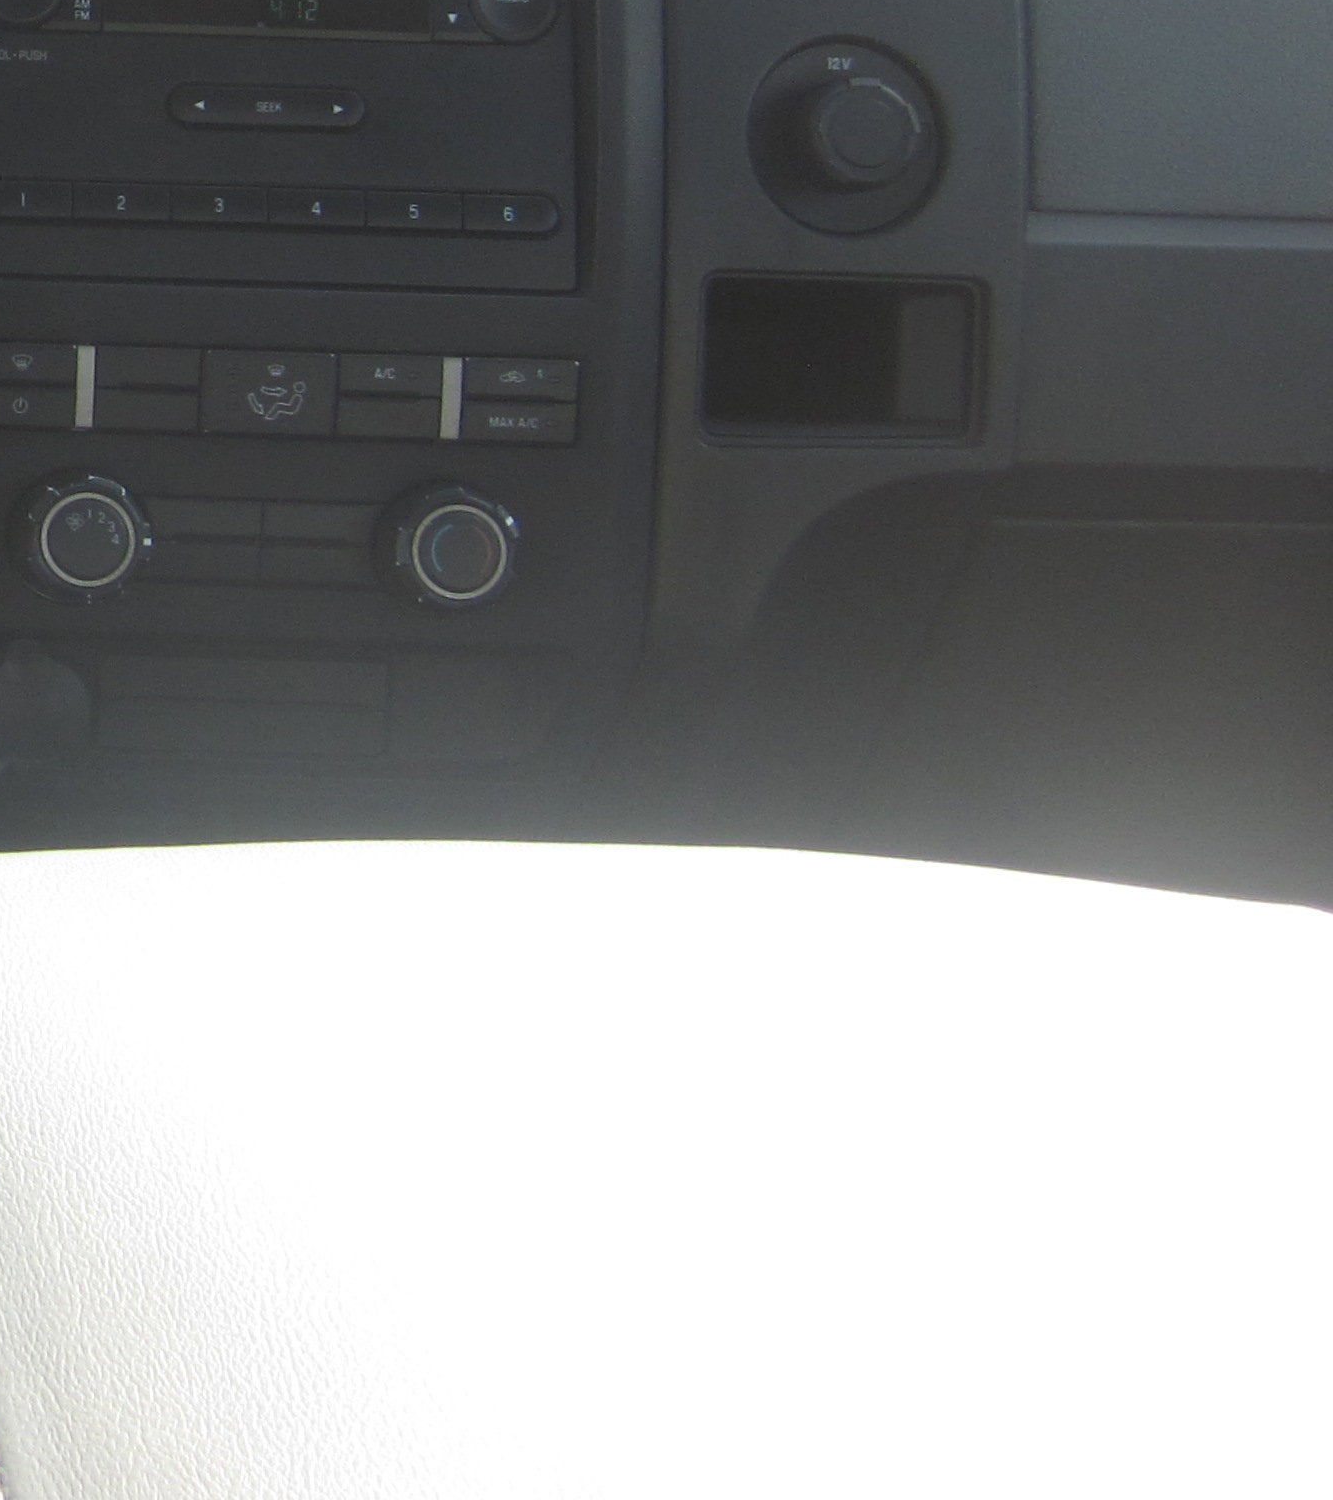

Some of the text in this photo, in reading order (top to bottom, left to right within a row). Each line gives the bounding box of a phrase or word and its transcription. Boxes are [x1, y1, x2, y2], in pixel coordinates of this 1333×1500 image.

[74, 10, 91, 20] FM
[114, 193, 128, 212] 2
[212, 196, 226, 215] 3
[309, 199, 323, 217] 4
[407, 202, 420, 220] 5
[501, 205, 515, 223] 6
[374, 367, 396, 380] A/C
[488, 416, 540, 428] MAX A/C
